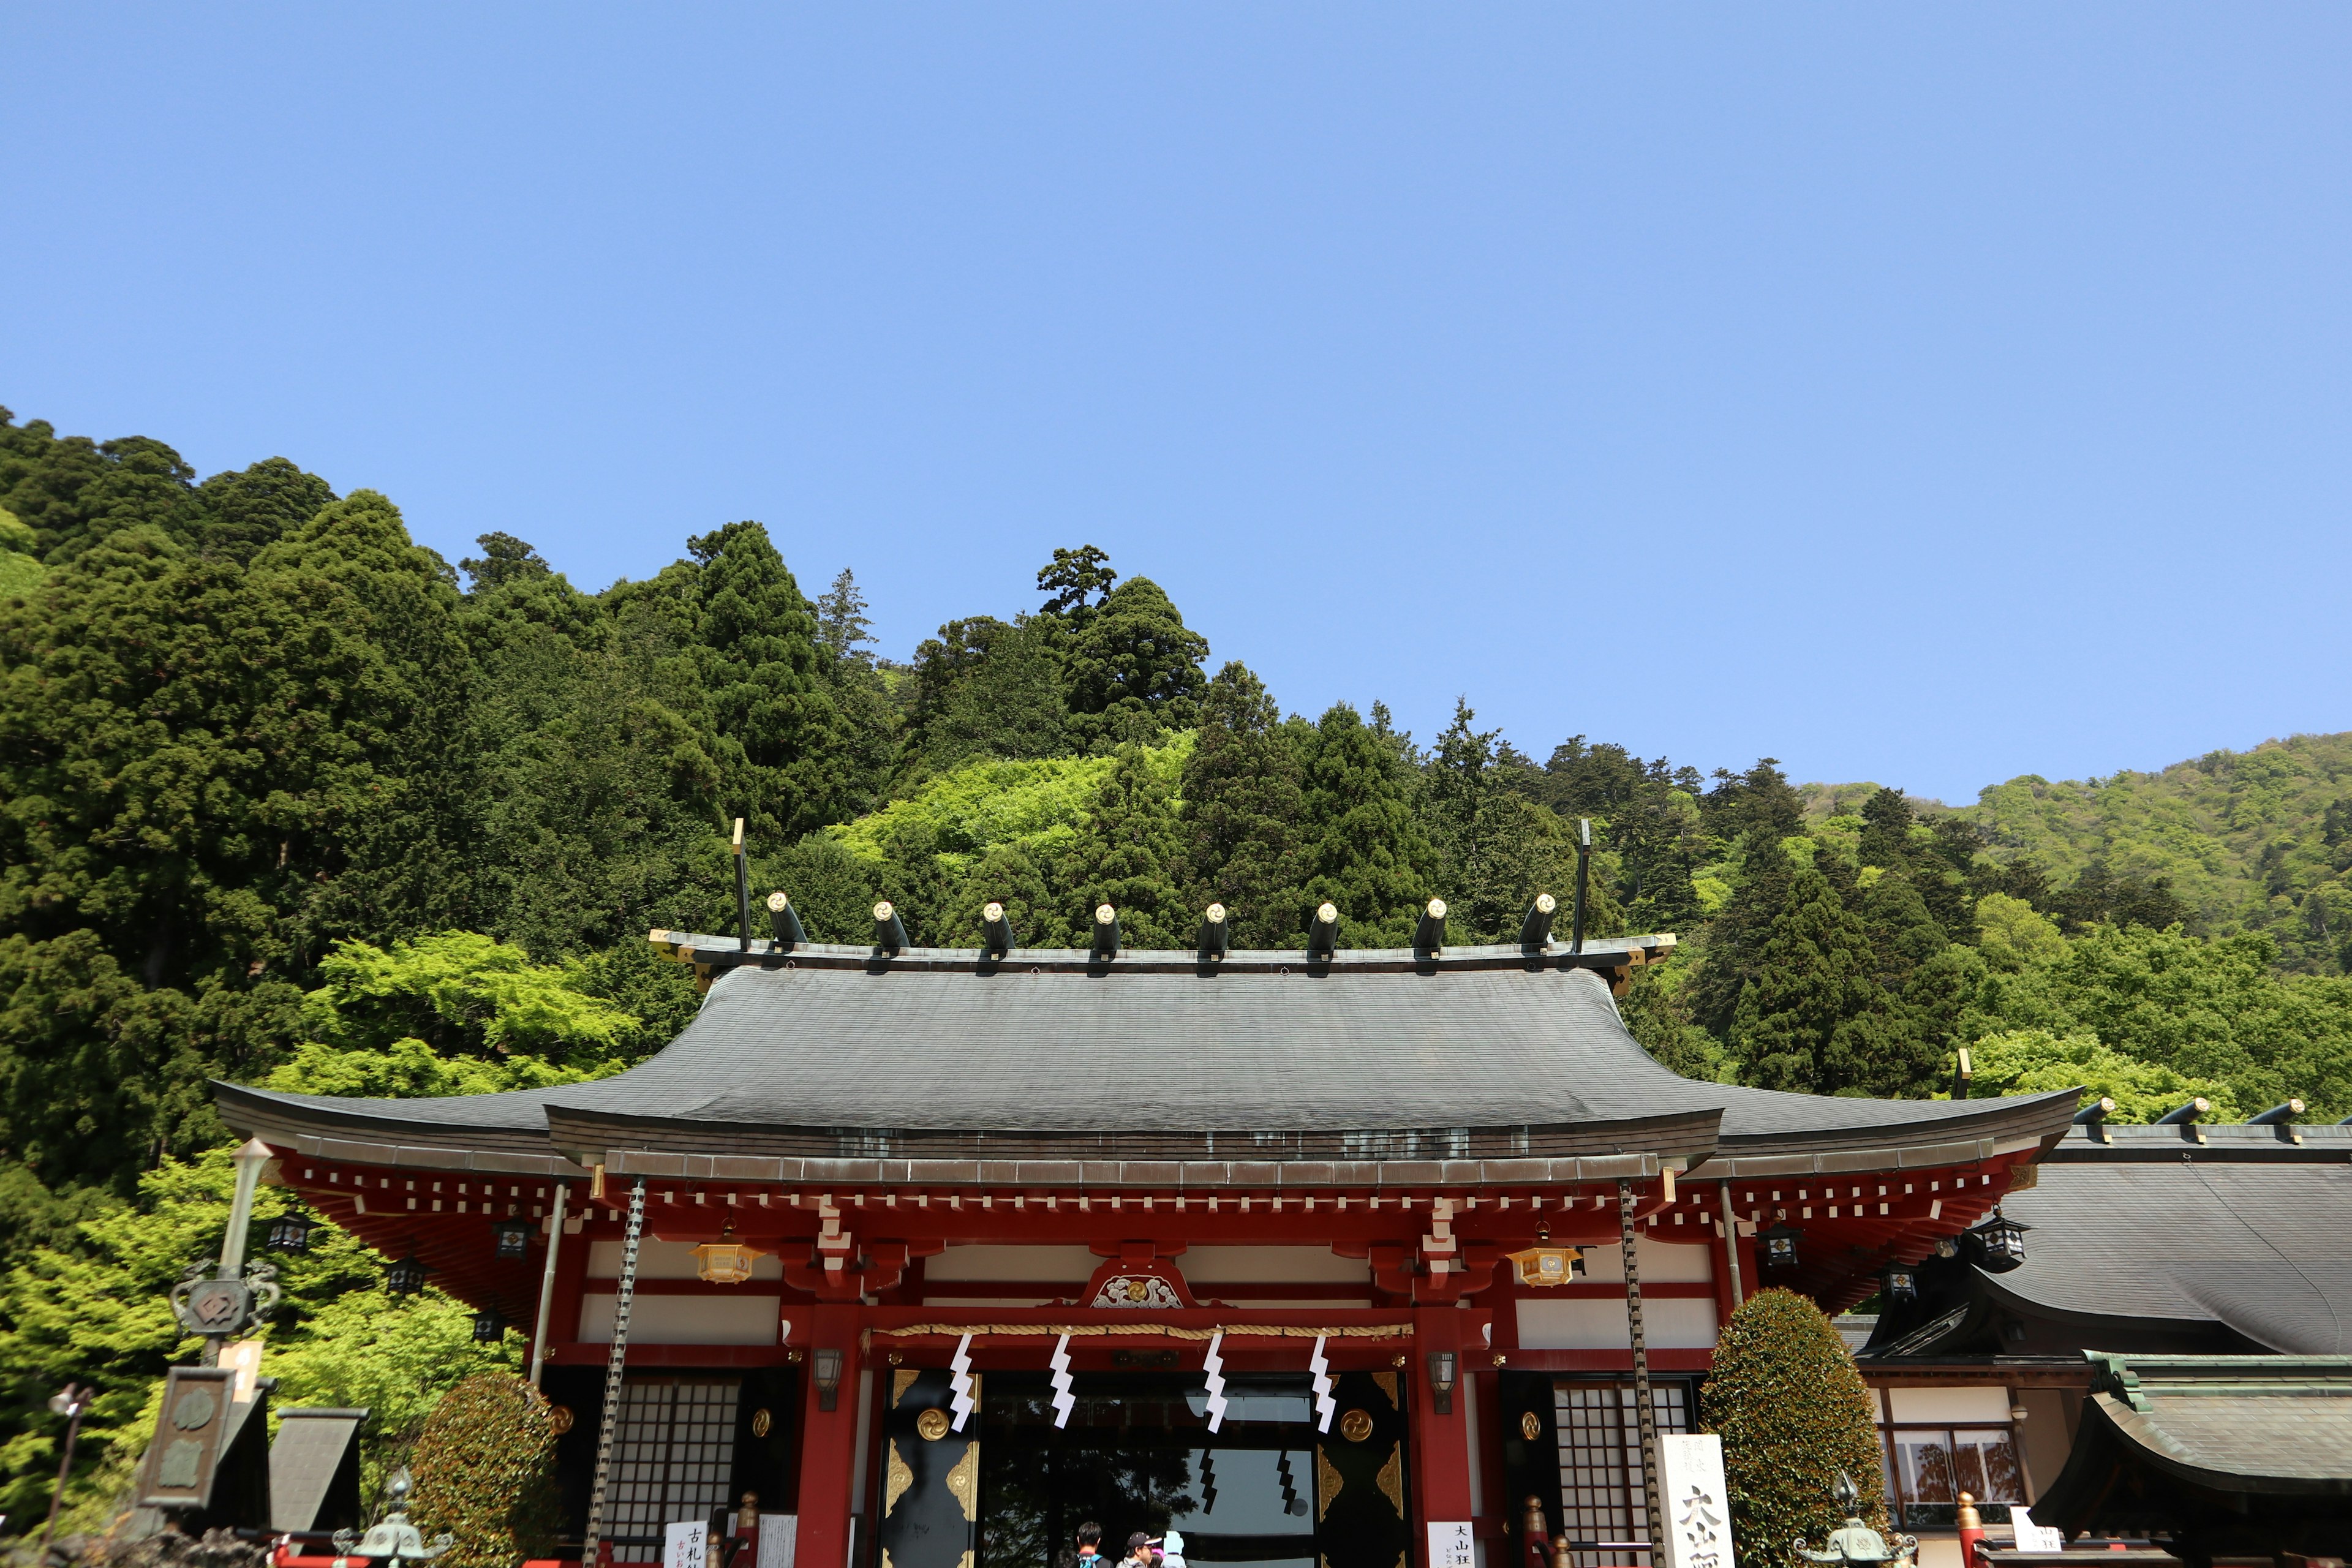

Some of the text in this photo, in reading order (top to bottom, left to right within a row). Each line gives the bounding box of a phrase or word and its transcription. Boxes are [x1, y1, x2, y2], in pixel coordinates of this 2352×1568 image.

[686, 1528, 702, 1568] 古札
[1455, 1525, 1470, 1565] 大山狂
